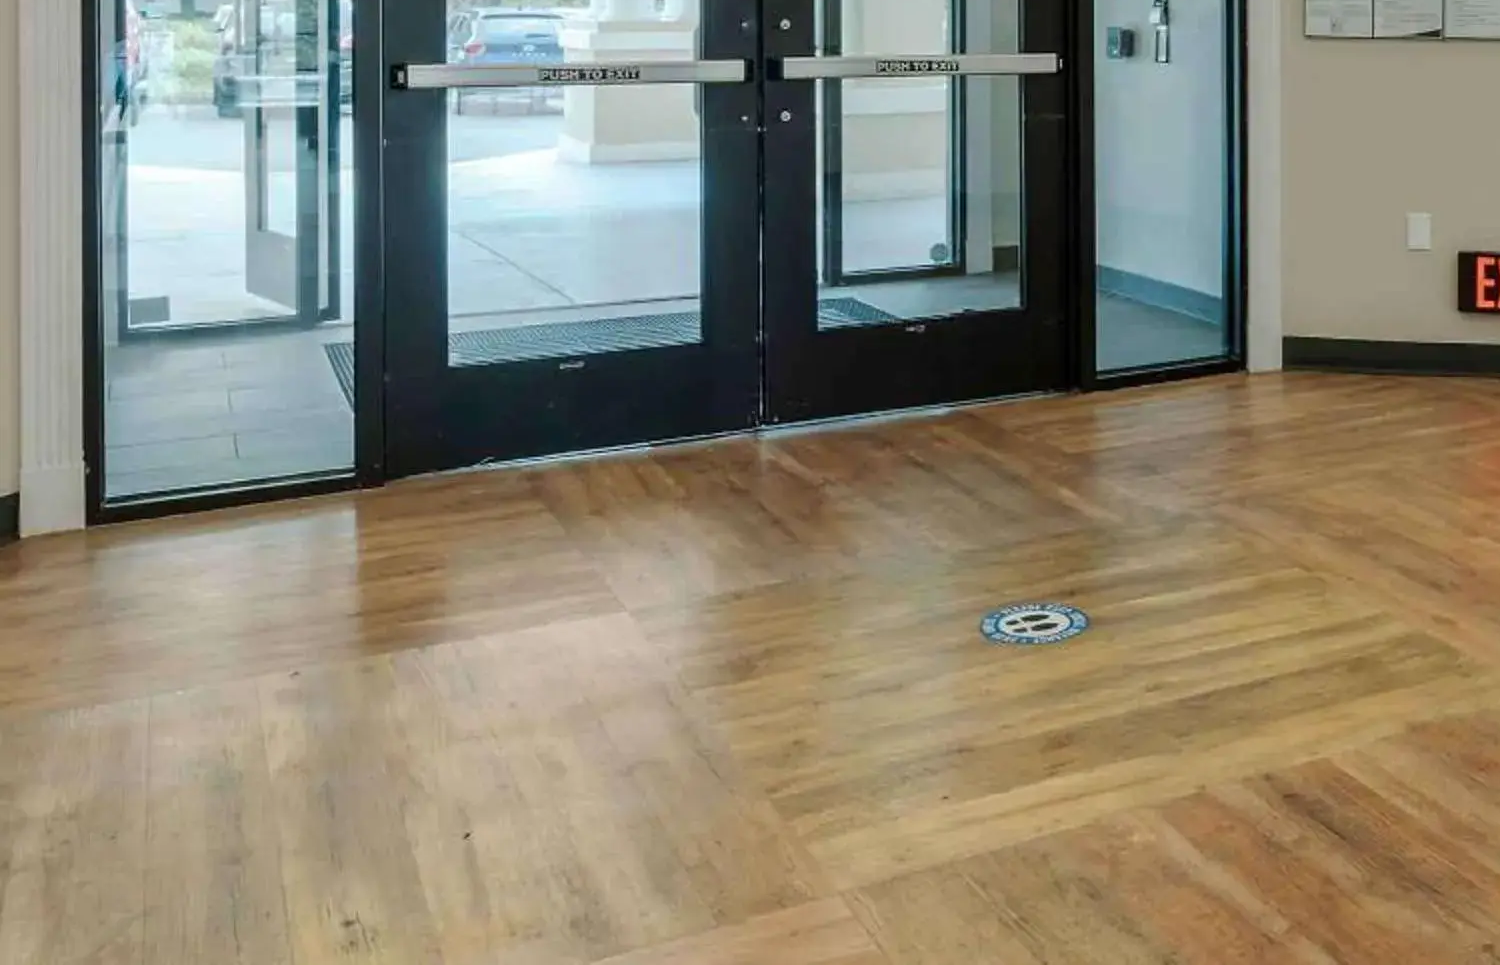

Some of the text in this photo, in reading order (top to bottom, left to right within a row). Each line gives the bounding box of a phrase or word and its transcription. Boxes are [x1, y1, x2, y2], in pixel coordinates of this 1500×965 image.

[541, 66, 639, 81] PUSH TO EXIT
[877, 60, 958, 73] PUSH TO EXIT
